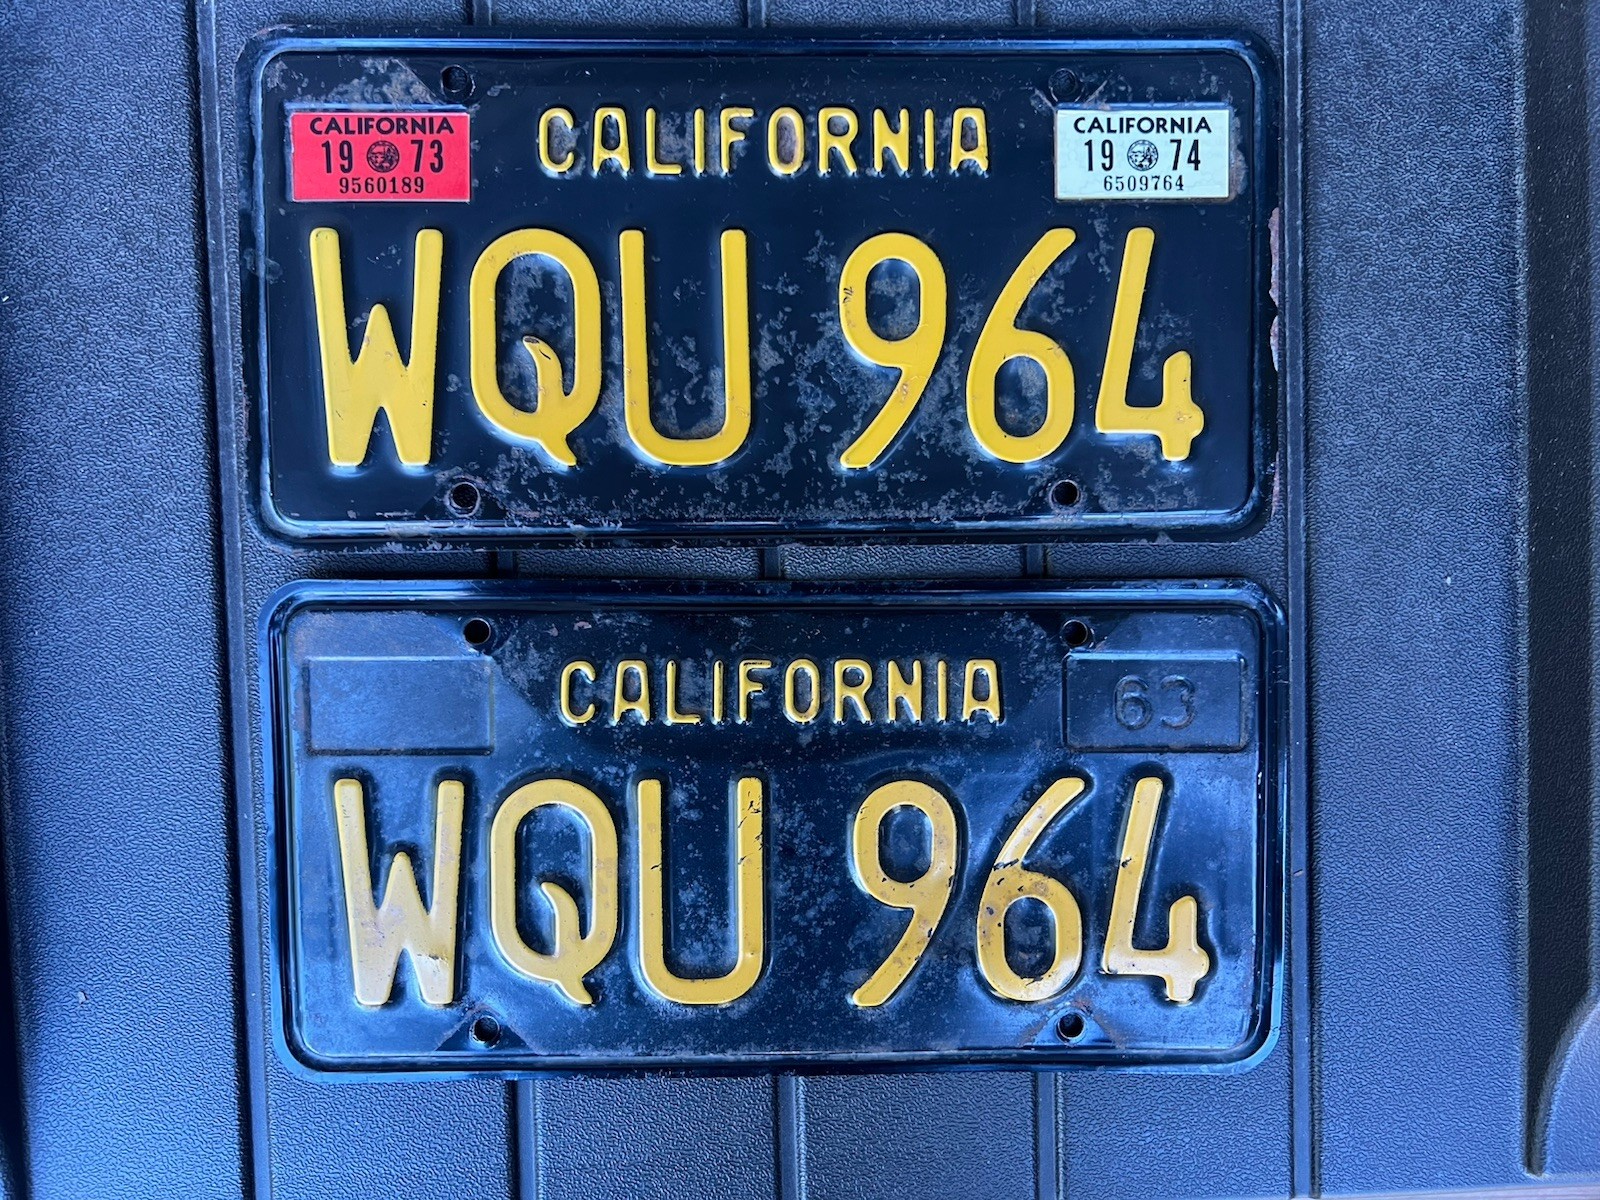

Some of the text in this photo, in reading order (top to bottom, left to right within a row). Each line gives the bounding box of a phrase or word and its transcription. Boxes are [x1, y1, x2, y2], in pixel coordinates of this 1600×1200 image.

[309, 116, 454, 135] CALIFORNIA
[538, 106, 989, 175] CALIFORNIA
[1073, 117, 1212, 134] CALIFORNIA
[322, 140, 445, 174] 19 73
[1084, 139, 1201, 171] 19 74
[339, 176, 425, 194] 9560189
[1103, 175, 1184, 192] 6509764
[309, 227, 1204, 469] WQU 964
[560, 658, 1001, 725] CALIFORNIA
[1114, 674, 1197, 731] 63
[334, 777, 1210, 1007] WQU 964
